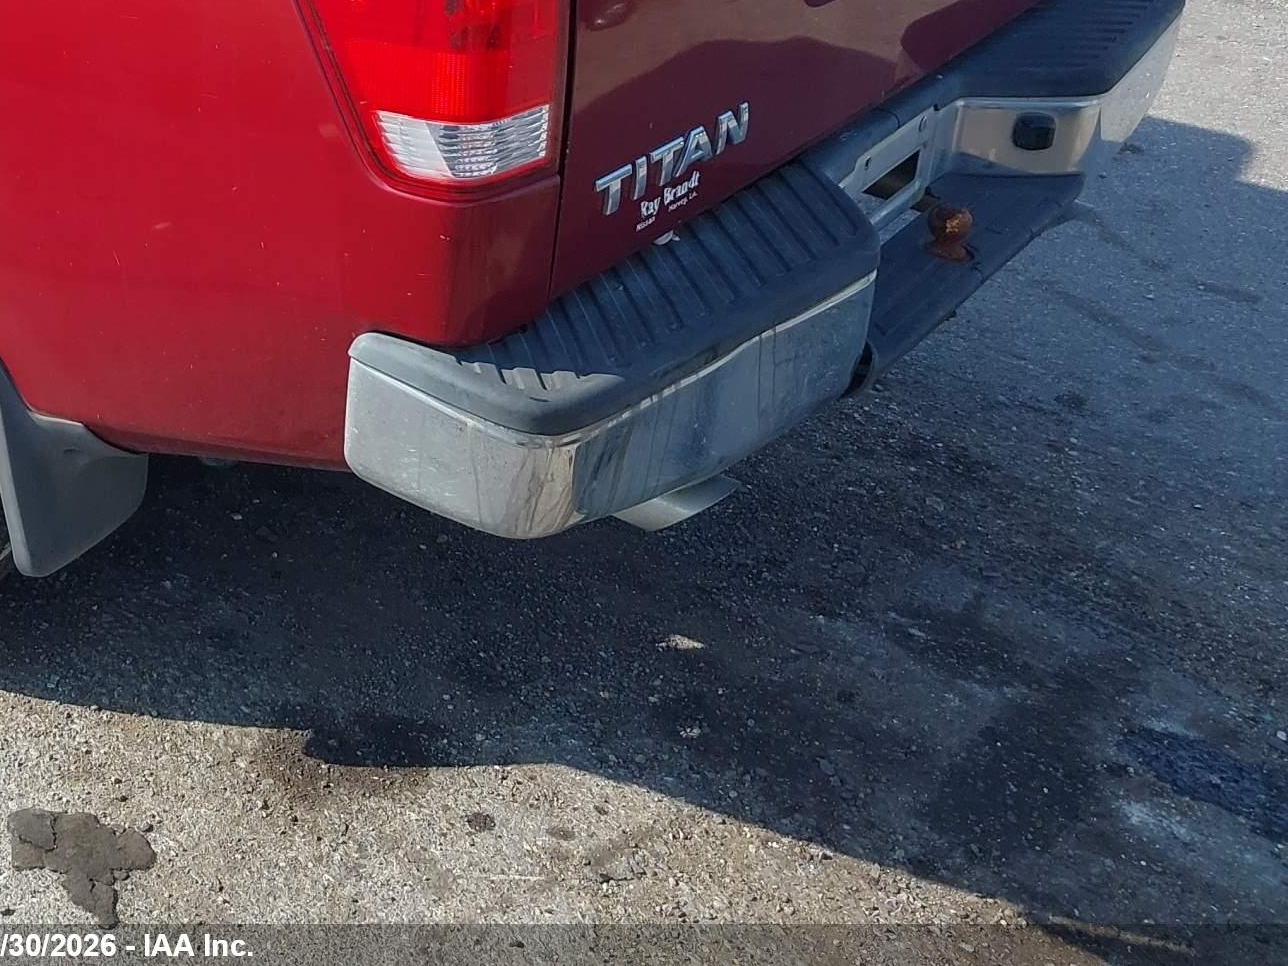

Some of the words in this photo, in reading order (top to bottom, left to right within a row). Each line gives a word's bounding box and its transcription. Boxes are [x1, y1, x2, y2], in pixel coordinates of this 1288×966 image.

[595, 101, 749, 216] TITAN
[640, 196, 661, 220] Ray
[663, 170, 700, 206] Brandt
